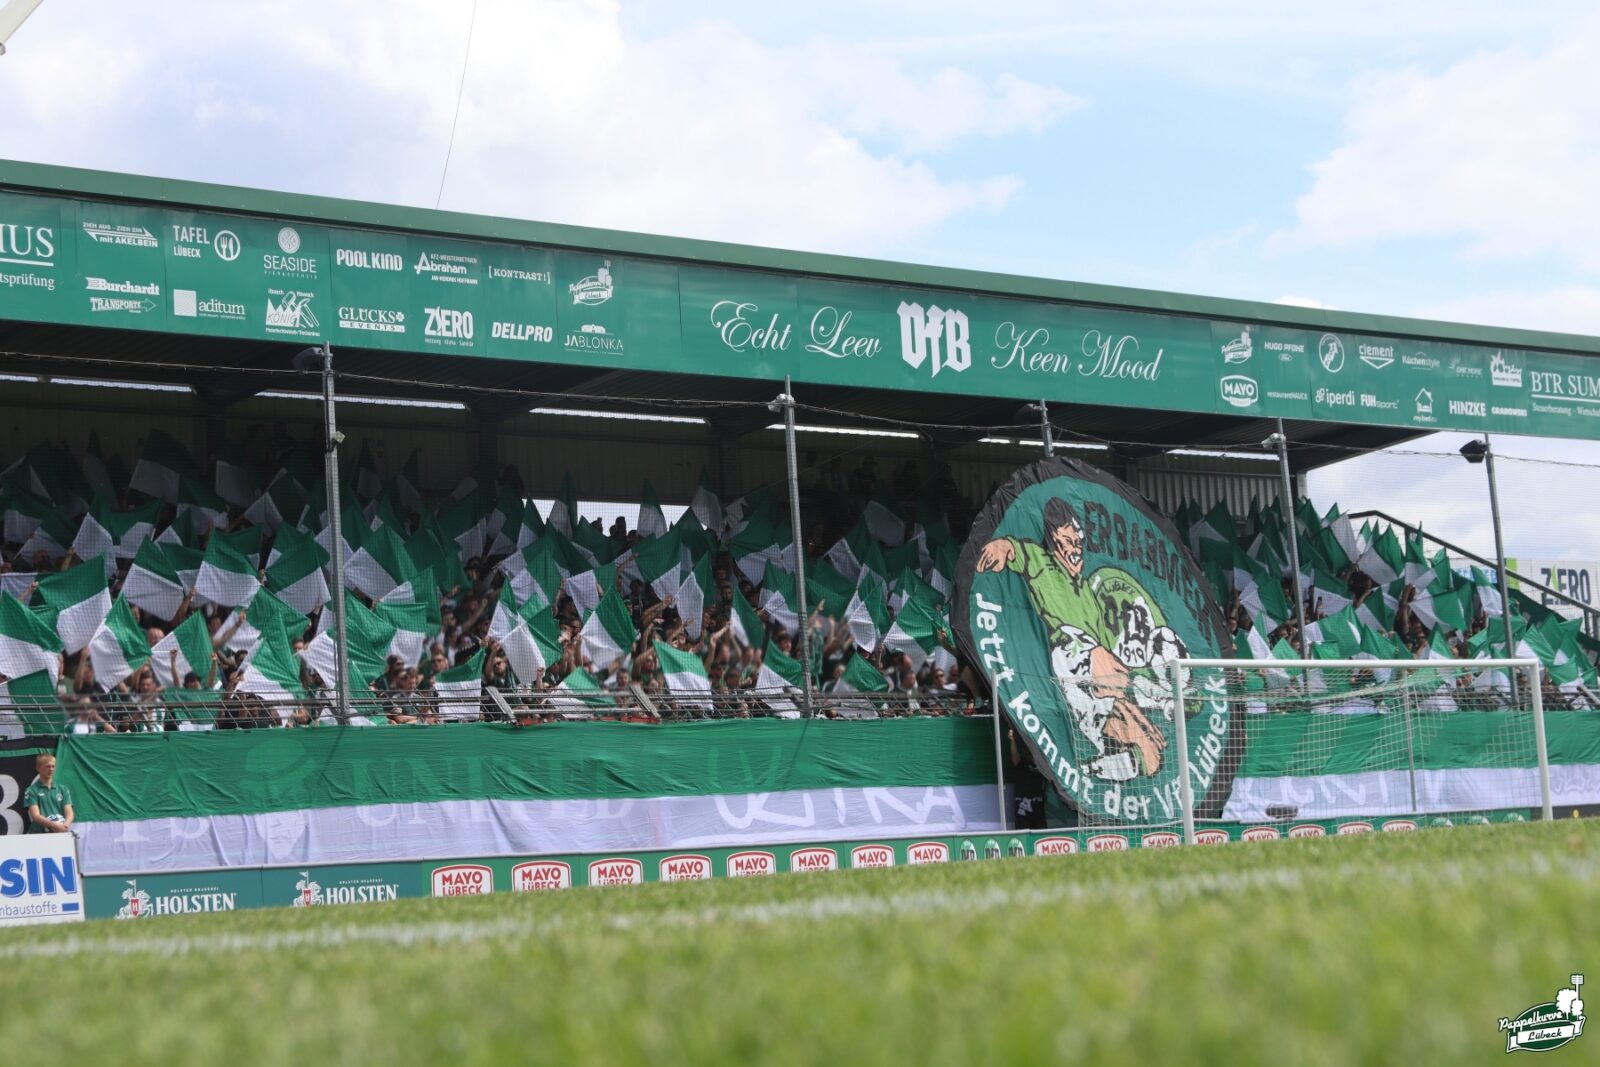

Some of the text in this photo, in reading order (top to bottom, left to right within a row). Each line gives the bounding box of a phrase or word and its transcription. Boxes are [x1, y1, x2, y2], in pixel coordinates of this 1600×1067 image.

[99, 235, 158, 248] mit AKELBEIN
[173, 225, 210, 245] TAFEL
[173, 245, 201, 258] LÜBECK
[263, 254, 317, 273] SEASIDE
[414, 252, 467, 275] Abraham
[97, 277, 160, 296] Burchardt
[198, 298, 245, 315] aditum
[338, 306, 396, 323] GLÜCKS
[350, 322, 396, 332] EVENTS
[424, 306, 474, 339] ZERO
[711, 300, 792, 352] Echt
[491, 322, 553, 343] DELLPRO
[896, 300, 972, 378] VfB
[564, 334, 624, 351] JABLONKA
[991, 321, 1164, 381] Keen Mood
[1264, 342, 1282, 351] HUGO
[1359, 344, 1394, 357] clement
[1224, 382, 1255, 396] MAYO
[1531, 371, 1564, 394] BTR
[1326, 389, 1355, 407] iperdi
[1448, 400, 1486, 416] HINZKE
[1119, 643, 1145, 664] 1919
[976, 592, 1015, 687] Jetzt
[1008, 690, 1094, 805] kommt
[1104, 782, 1151, 820] der
[914, 847, 942, 860] MAYO
[1042, 842, 1071, 855] MAYO
[1094, 840, 1122, 851] MAYO
[735, 857, 768, 870] MAYO
[798, 854, 830, 867] MAYO
[858, 850, 887, 863] MAYO
[522, 867, 561, 882] MAYO
[597, 864, 634, 878] MAYO
[668, 861, 704, 874] MAYO
[442, 871, 483, 886] MAYO
[326, 884, 397, 905] HOLSTEN
[155, 892, 235, 915] HOLSTEN
